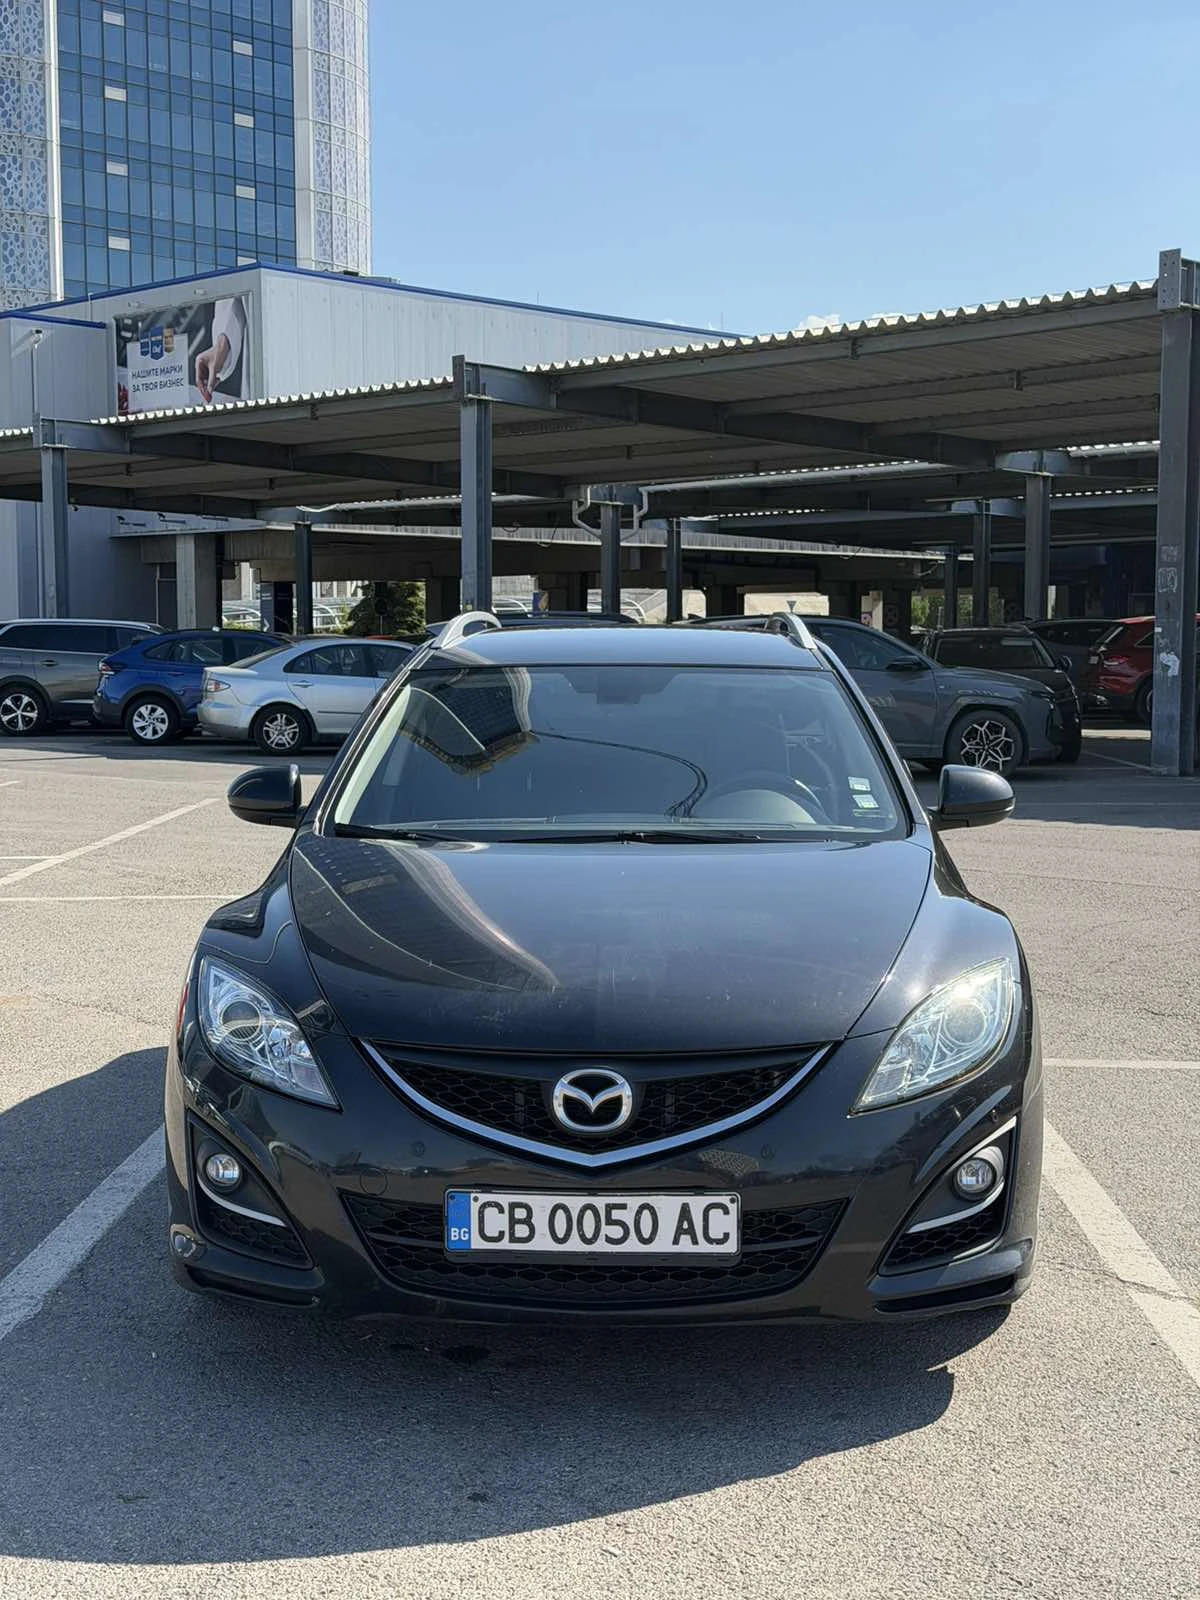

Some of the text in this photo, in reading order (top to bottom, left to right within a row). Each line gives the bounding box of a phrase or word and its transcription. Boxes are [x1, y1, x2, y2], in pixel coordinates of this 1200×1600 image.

[132, 364, 183, 379] НАШИТЕ МАРКИ
[132, 378, 184, 392] ЗА ТВОЯ БИЗНЕС
[477, 1201, 730, 1246] CB 0050 AC
[450, 1227, 470, 1241] BG
